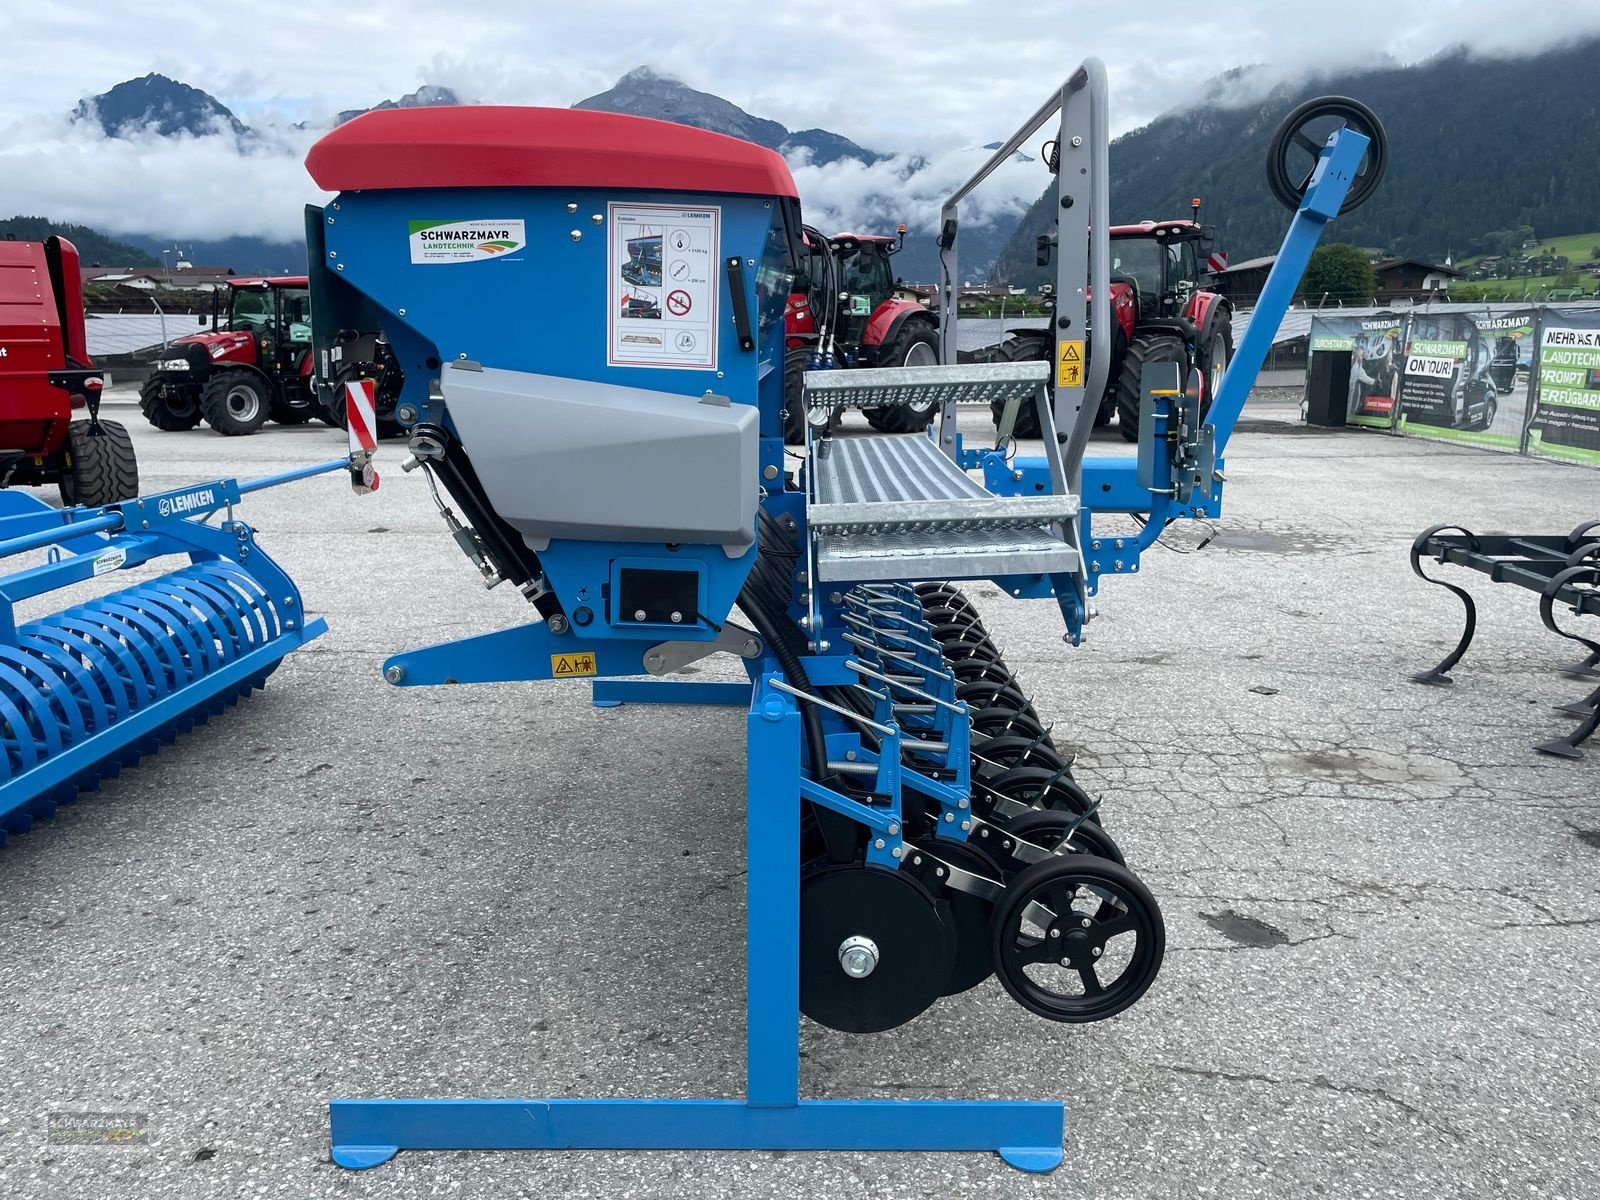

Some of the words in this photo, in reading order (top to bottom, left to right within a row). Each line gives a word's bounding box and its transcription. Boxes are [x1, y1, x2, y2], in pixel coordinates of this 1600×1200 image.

[420, 230, 510, 241] SCHWARZMAYR
[423, 242, 475, 250] LANDTECHNIK
[1546, 331, 1576, 345] MEHR
[1409, 359, 1426, 373] ON
[169, 489, 215, 514] LEMKEN
